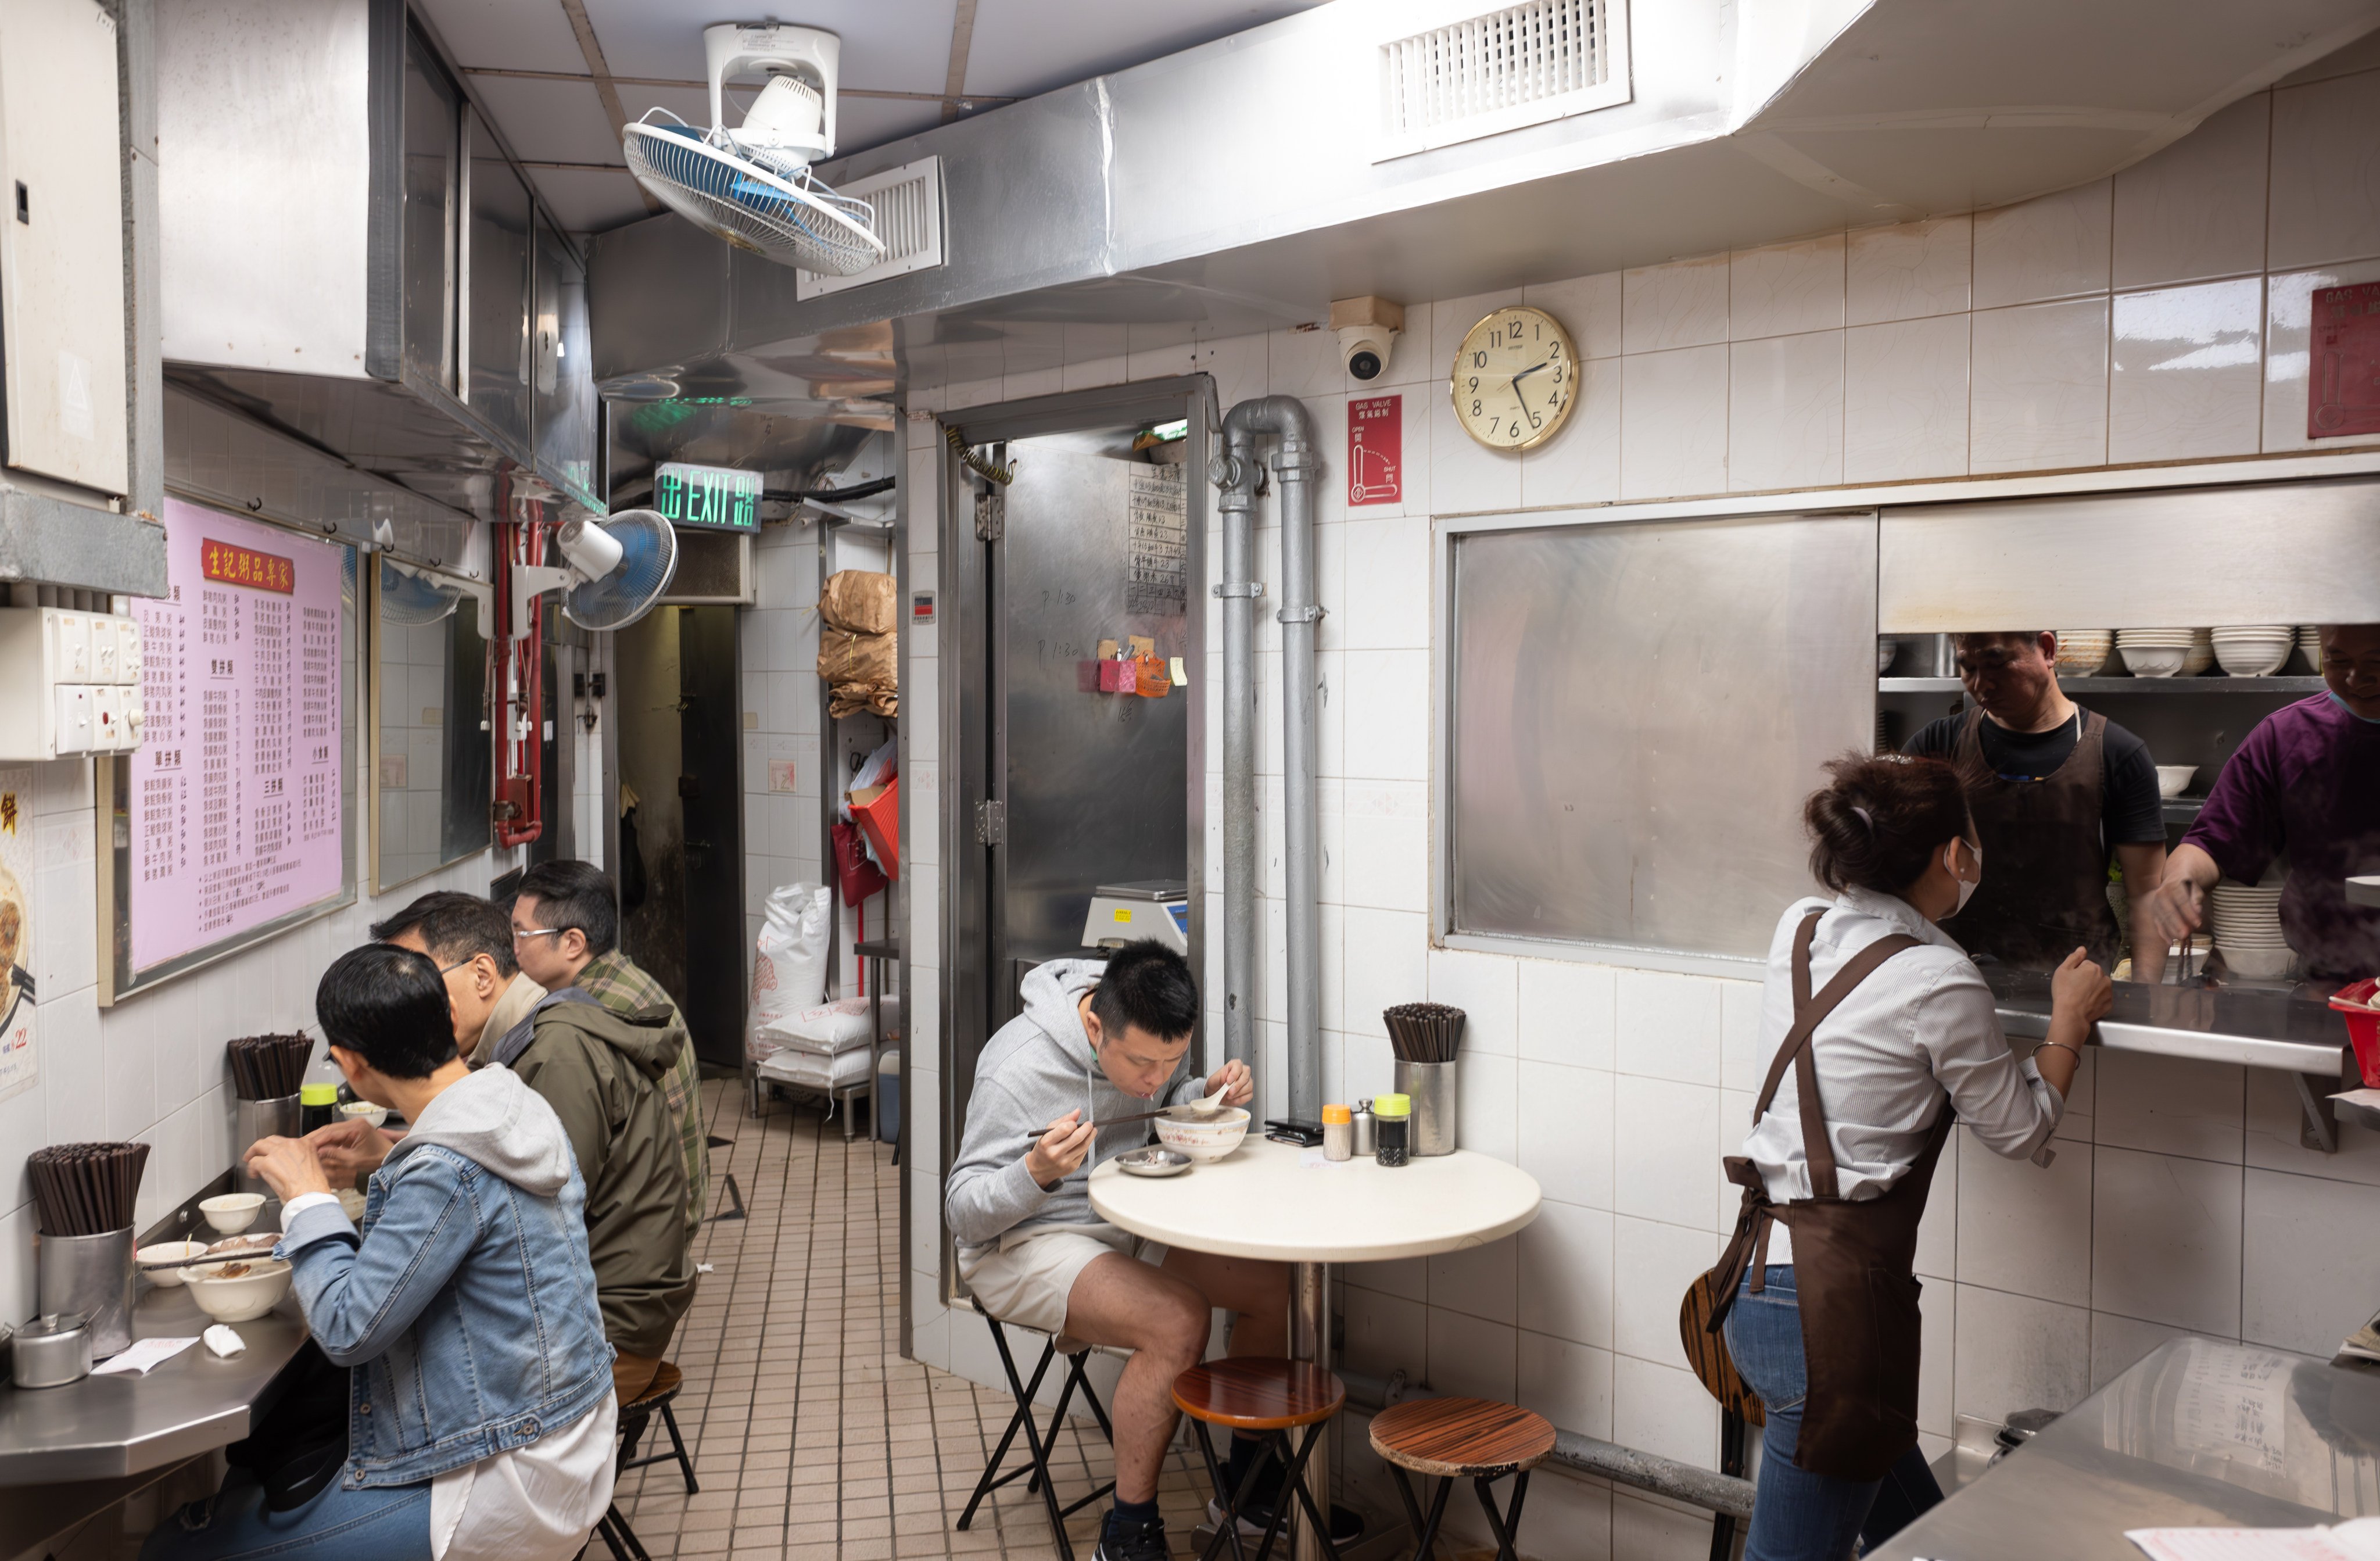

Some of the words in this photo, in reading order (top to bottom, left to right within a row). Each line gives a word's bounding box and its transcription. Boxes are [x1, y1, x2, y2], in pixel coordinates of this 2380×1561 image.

[1508, 321, 1522, 339] 12
[1535, 324, 1539, 341] 1
[1490, 330, 1501, 349] 11
[1550, 341, 1560, 359] 2
[1473, 350, 1487, 369] 10
[1553, 366, 1562, 384] 3
[1469, 377, 1479, 394] 9
[1356, 402, 1368, 410] GAS
[1372, 399, 1391, 409] VALVE
[1548, 390, 1558, 407] 4
[1472, 399, 1482, 417] 8
[1490, 417, 1500, 434] 7
[1533, 411, 1542, 429] 5
[1510, 421, 1519, 438] 6
[661, 468, 682, 520] 出
[687, 470, 732, 525] EXIT
[733, 475, 756, 527] 路
[209, 545, 289, 590] 生記粥品專家
